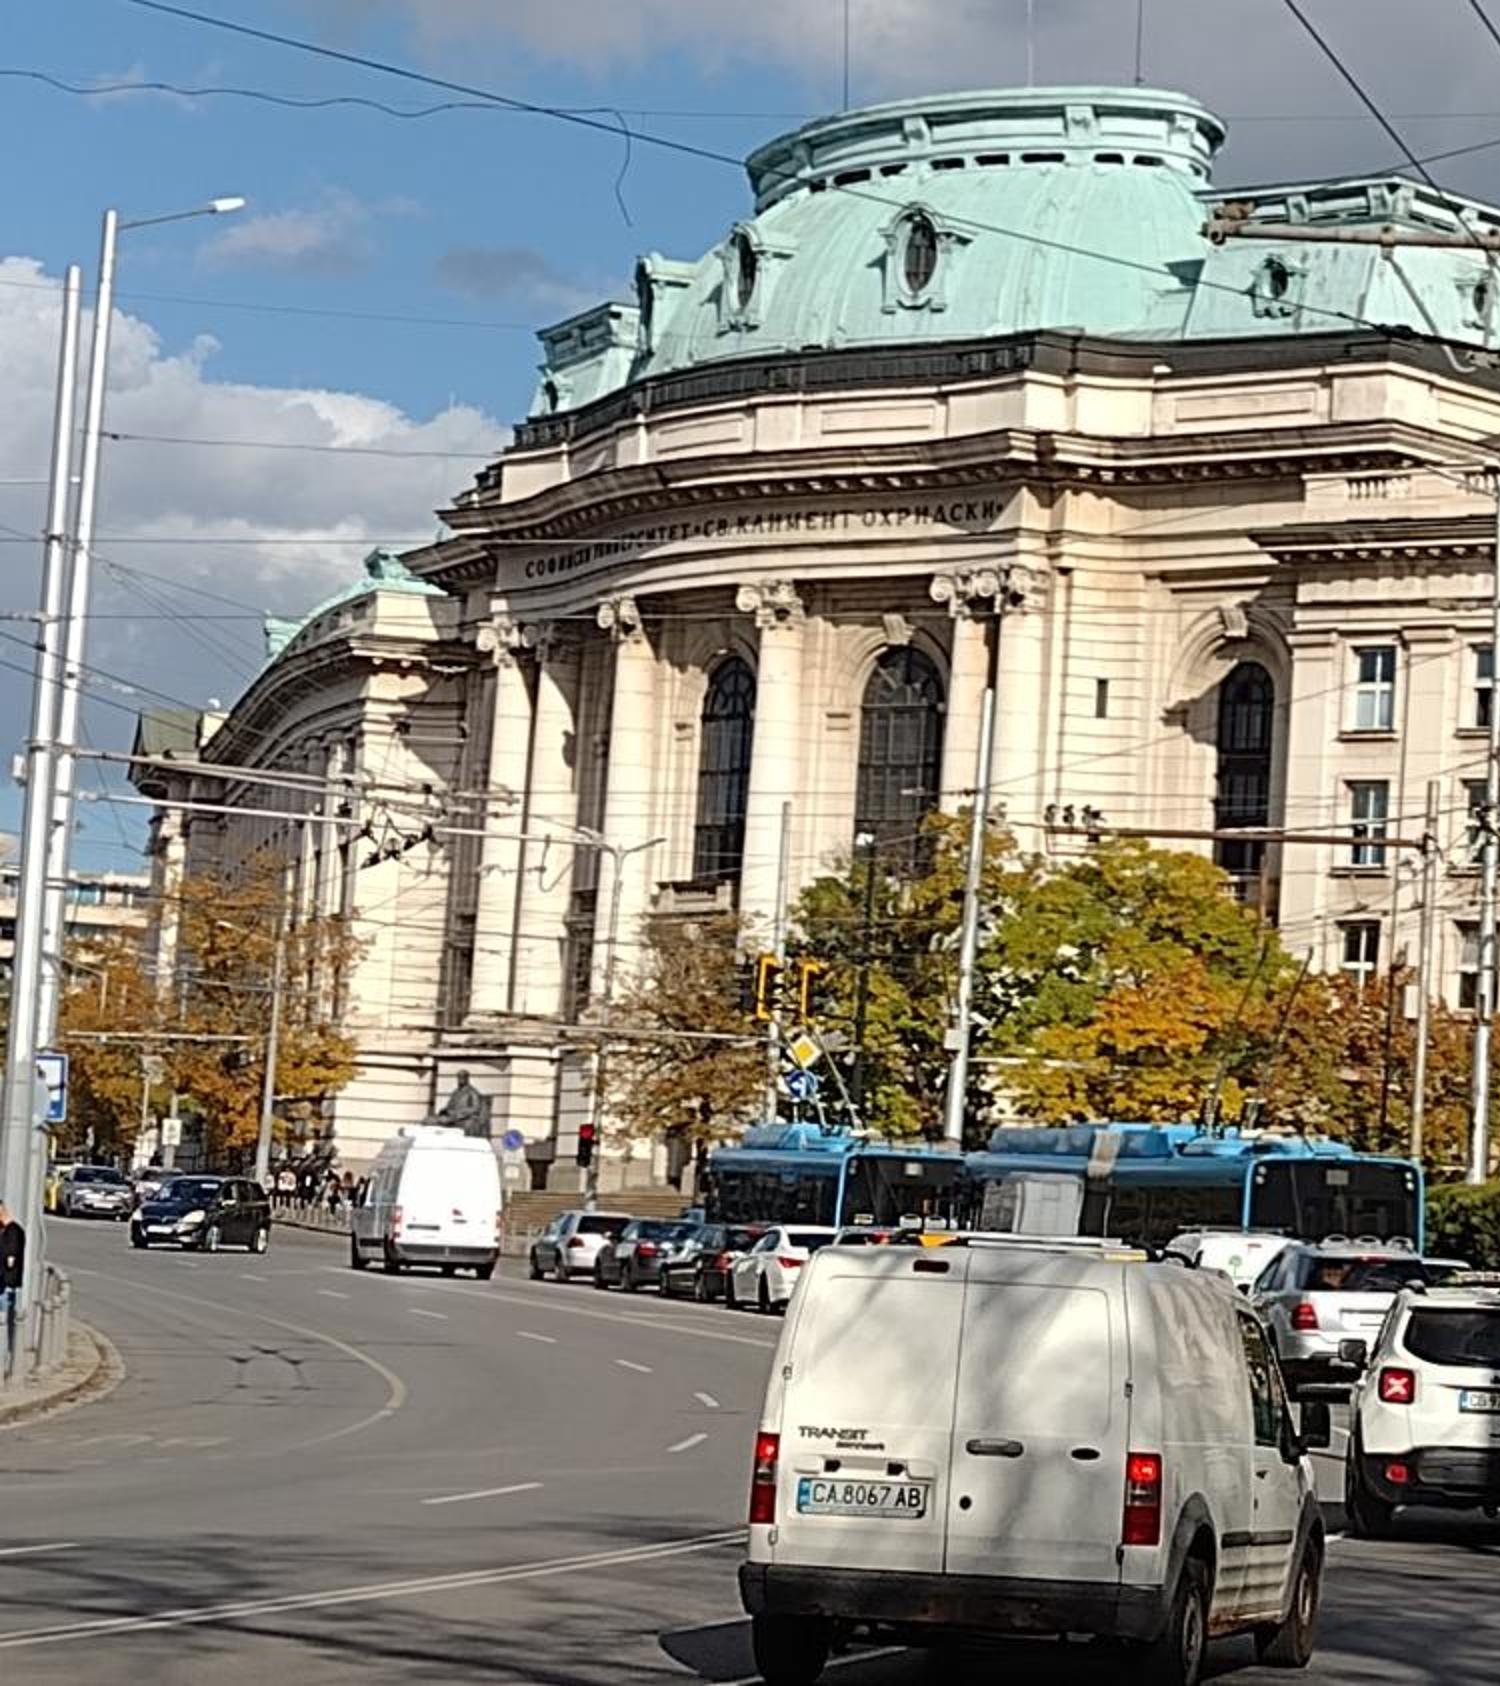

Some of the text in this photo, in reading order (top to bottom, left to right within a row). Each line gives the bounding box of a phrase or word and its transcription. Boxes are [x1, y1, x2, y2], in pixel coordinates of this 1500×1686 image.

[737, 510, 854, 534] КЛИМЕНТ
[861, 501, 995, 527] ОХРИДСКИ
[798, 1426, 868, 1440] TRANSIT
[812, 1483, 921, 1508] CA 8067 AB
